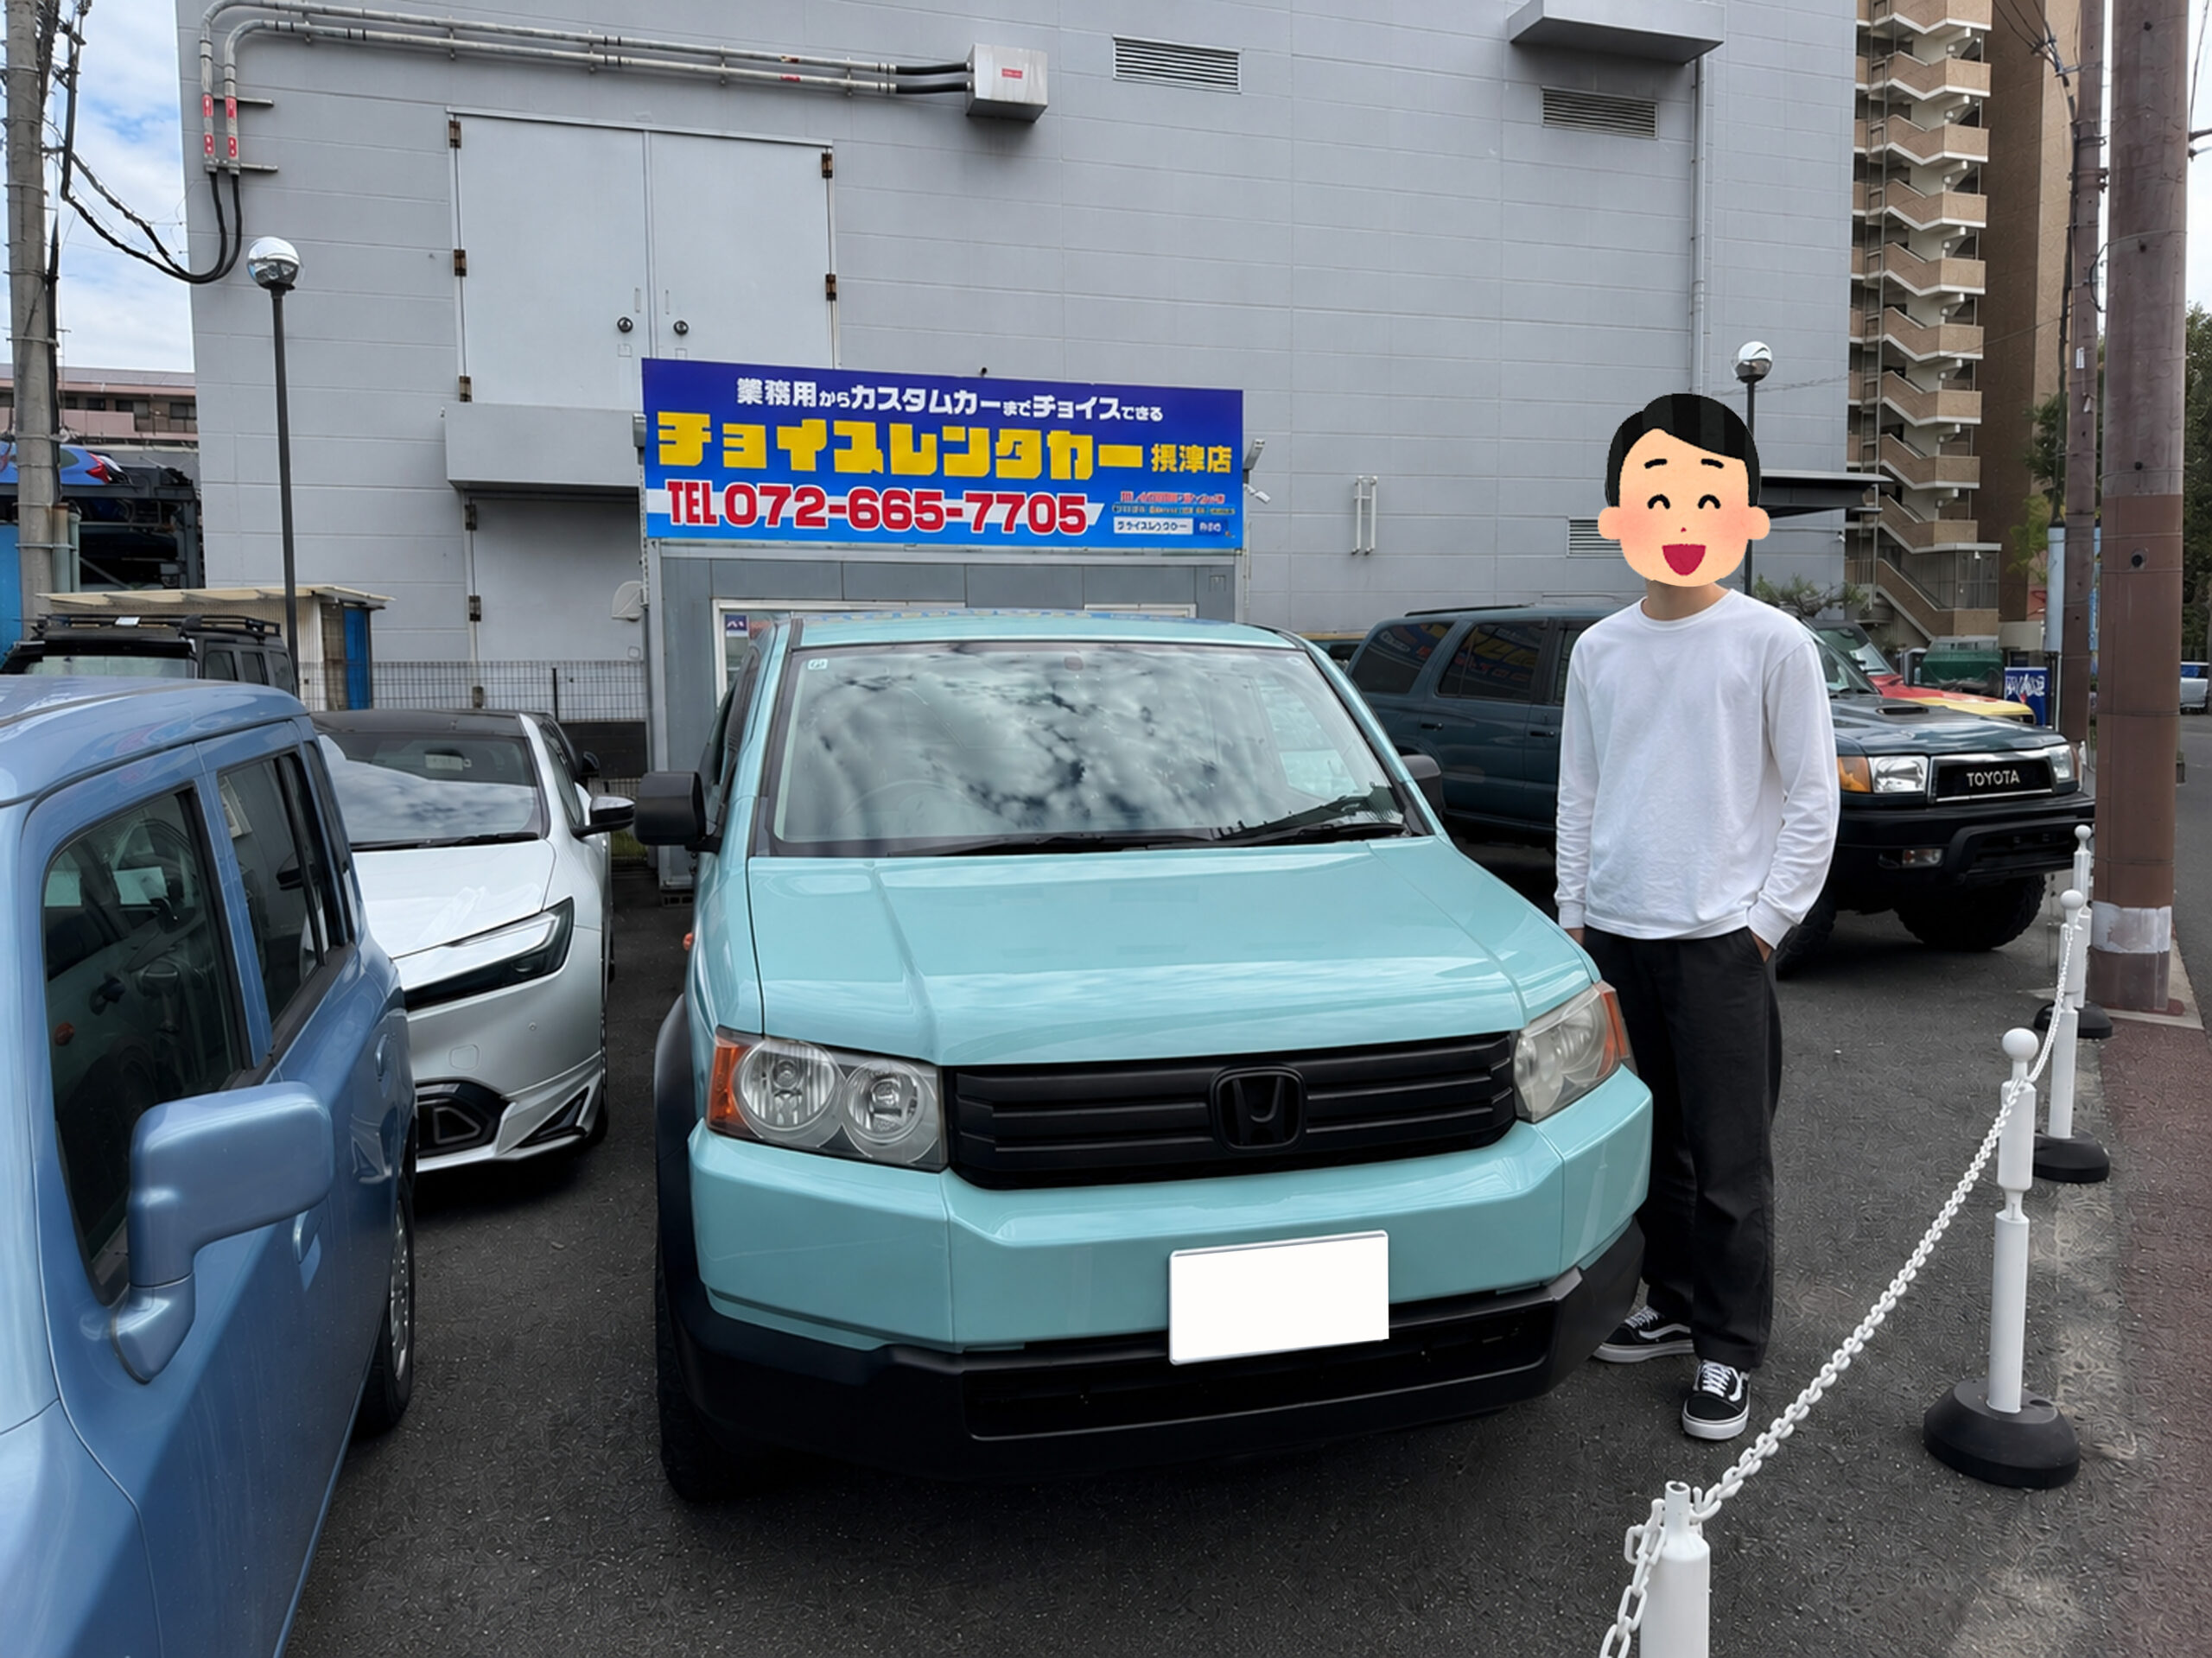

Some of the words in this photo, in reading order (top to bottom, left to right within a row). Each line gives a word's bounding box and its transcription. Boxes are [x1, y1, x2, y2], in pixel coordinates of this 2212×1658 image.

[737, 378, 1164, 422] 業務用からカスタムカーまでチョイスできる
[658, 412, 1142, 480] チョイスレンタカー
[1152, 444, 1231, 473] 摂津店
[668, 480, 717, 524] TEL
[725, 485, 1086, 534] 072-665-7705
[1967, 771, 2020, 787] TOYOTA
